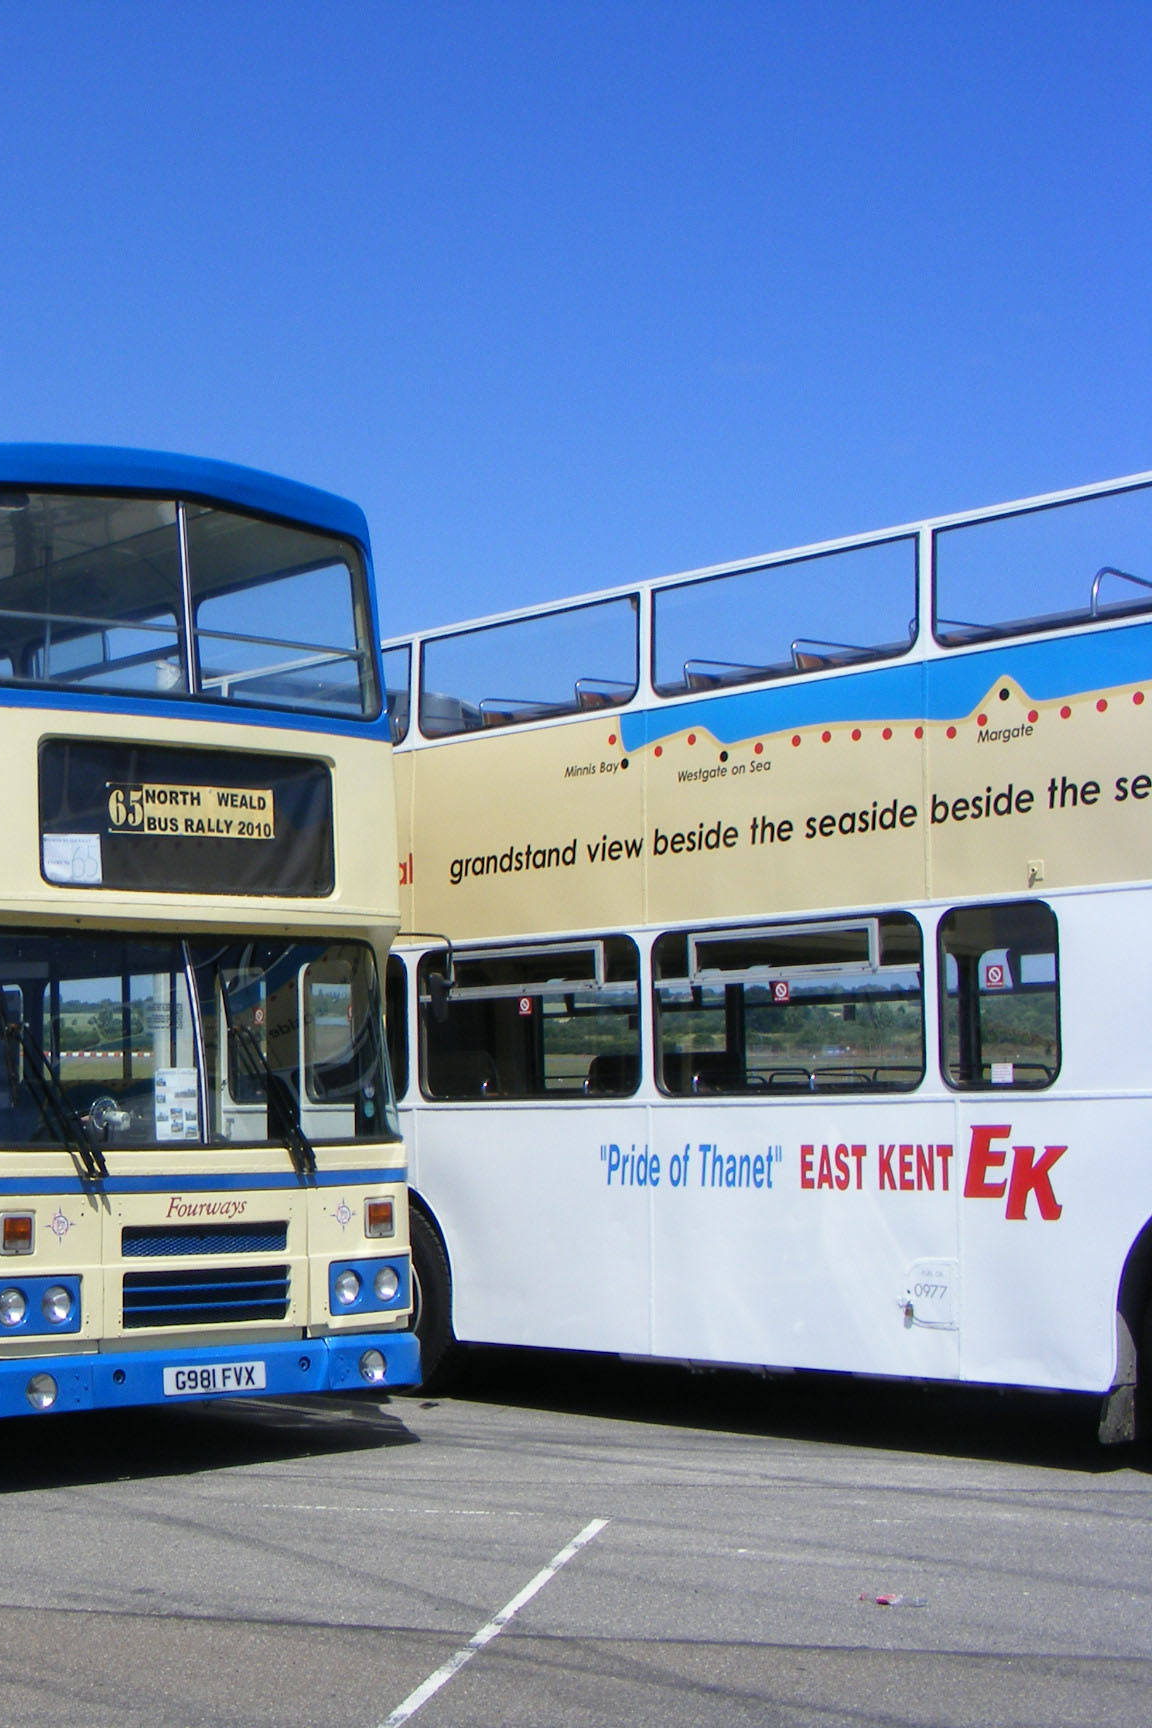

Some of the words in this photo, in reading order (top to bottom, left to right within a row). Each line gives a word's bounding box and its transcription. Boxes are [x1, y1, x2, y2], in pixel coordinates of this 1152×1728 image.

[977, 724, 1034, 744] Margate
[564, 763, 595, 778] Minnis
[600, 761, 620, 776] Bay
[677, 765, 728, 783] Westgate
[731, 764, 746, 776] on
[750, 759, 771, 774] Sea
[107, 788, 145, 827] 65
[145, 788, 201, 807] NORTH
[217, 791, 266, 811] WEALD
[147, 816, 179, 832] BUS
[184, 817, 233, 835] RALLY
[237, 820, 272, 838] 2010
[450, 838, 578, 885] grandstand
[587, 834, 644, 863] view
[653, 820, 738, 857] beside
[749, 815, 794, 846] the
[805, 799, 918, 840] seaside
[930, 784, 1035, 825] beside
[1047, 775, 1101, 809] the
[1114, 774, 1152, 802] se
[600, 1143, 661, 1187] "Pride
[669, 1143, 691, 1187] of
[698, 1143, 783, 1189] Thanet"
[800, 1144, 867, 1191] EAST
[878, 1144, 954, 1191] KENT
[165, 1196, 248, 1219] Fourways
[914, 1282, 949, 1299] 0977
[175, 1368, 218, 1392] G981
[222, 1365, 256, 1388] FVX
